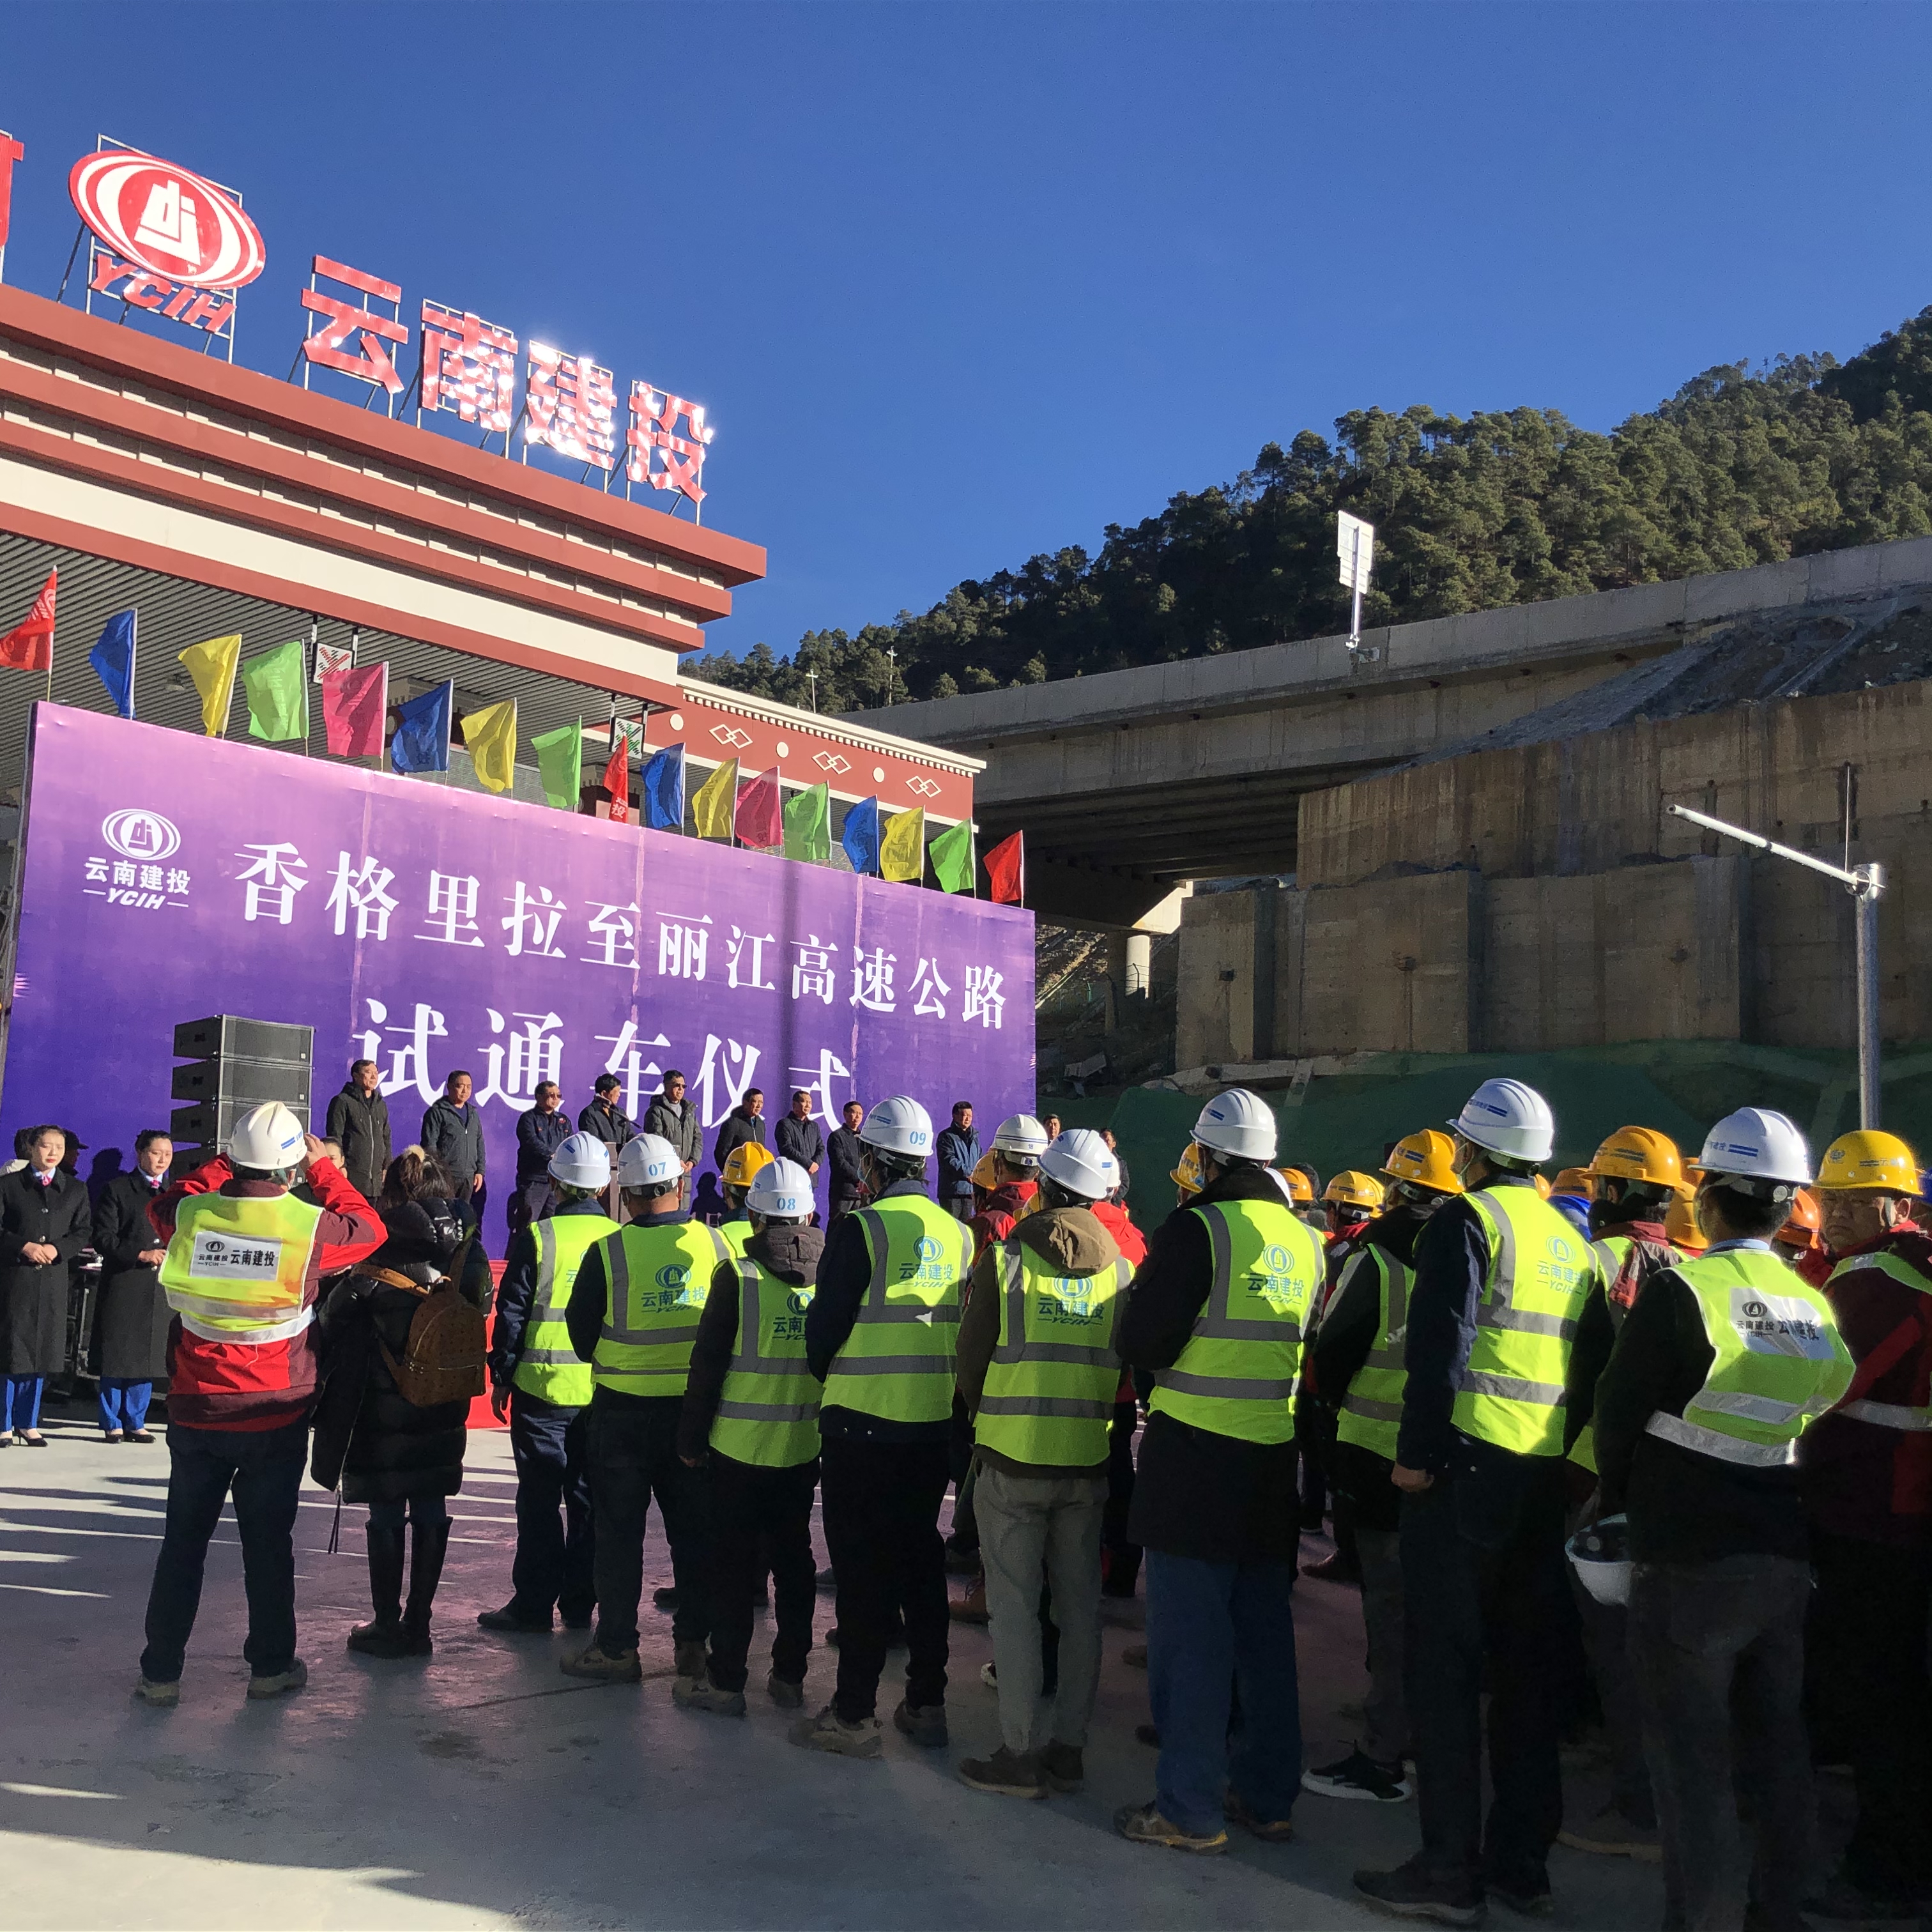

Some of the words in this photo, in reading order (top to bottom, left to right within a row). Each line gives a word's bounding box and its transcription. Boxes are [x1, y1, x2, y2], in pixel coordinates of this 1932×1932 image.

[89, 254, 237, 333] YCIH
[301, 254, 710, 503] 云南建投
[84, 856, 190, 895] 云南建投
[107, 887, 166, 910] YCIH
[234, 842, 1008, 1030] 香格里拉至丽江高速公路
[352, 997, 851, 1131] 试通车仪式
[909, 1131, 926, 1146] 09
[648, 1161, 666, 1177] 07
[776, 1197, 796, 1211] 08
[198, 1254, 229, 1262] 云南建投
[229, 1249, 275, 1267] 云南建投
[898, 1262, 954, 1280] 云南建投
[1537, 1259, 1583, 1287] 云南建投
[641, 1285, 706, 1307] 云南建投
[1247, 1272, 1305, 1298] 云南建投
[1038, 1297, 1105, 1320] 云南建投
[772, 1317, 806, 1333] 云南
